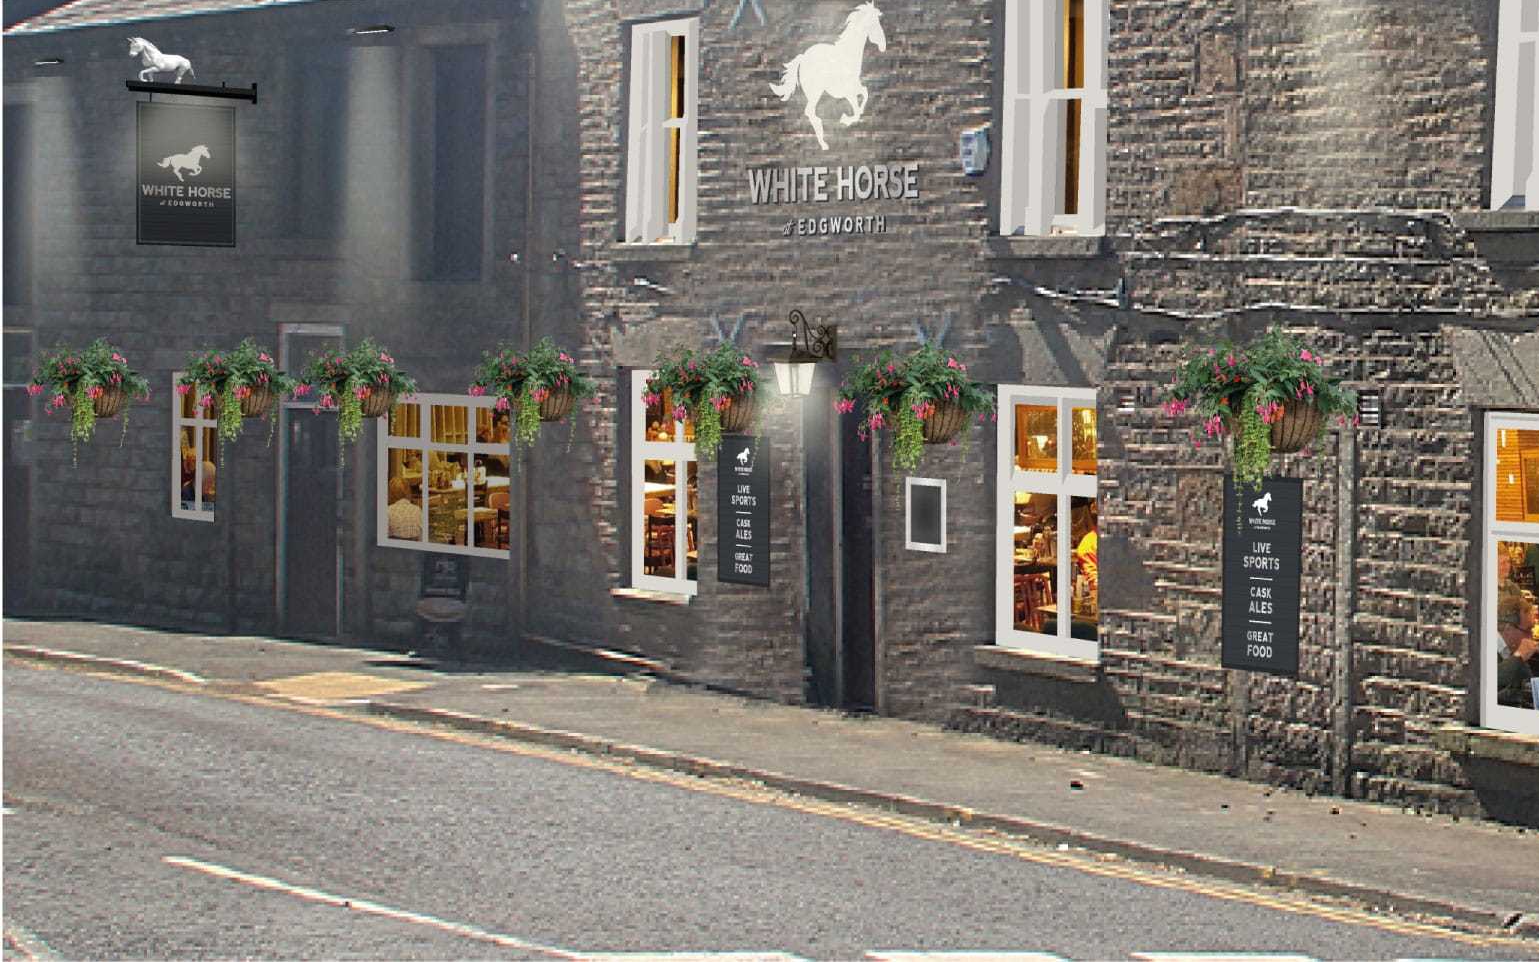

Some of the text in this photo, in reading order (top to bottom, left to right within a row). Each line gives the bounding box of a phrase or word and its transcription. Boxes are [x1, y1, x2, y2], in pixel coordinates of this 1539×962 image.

[748, 163, 919, 204] WHITE HORSE
[141, 184, 231, 199] WHITE HORSE
[797, 215, 887, 236] EDGWORTH
[737, 484, 751, 494] LIVE
[731, 495, 757, 507] SPORTS
[735, 529, 753, 541] ALES
[1252, 541, 1272, 554] LIVE
[734, 551, 753, 563] GREAT
[1243, 555, 1280, 571] SPORTS
[734, 562, 753, 575] FOOD
[1250, 586, 1272, 599] CASK
[1248, 600, 1273, 615] ALES
[1246, 630, 1274, 643] GREAT
[1247, 644, 1273, 659] FOOD
